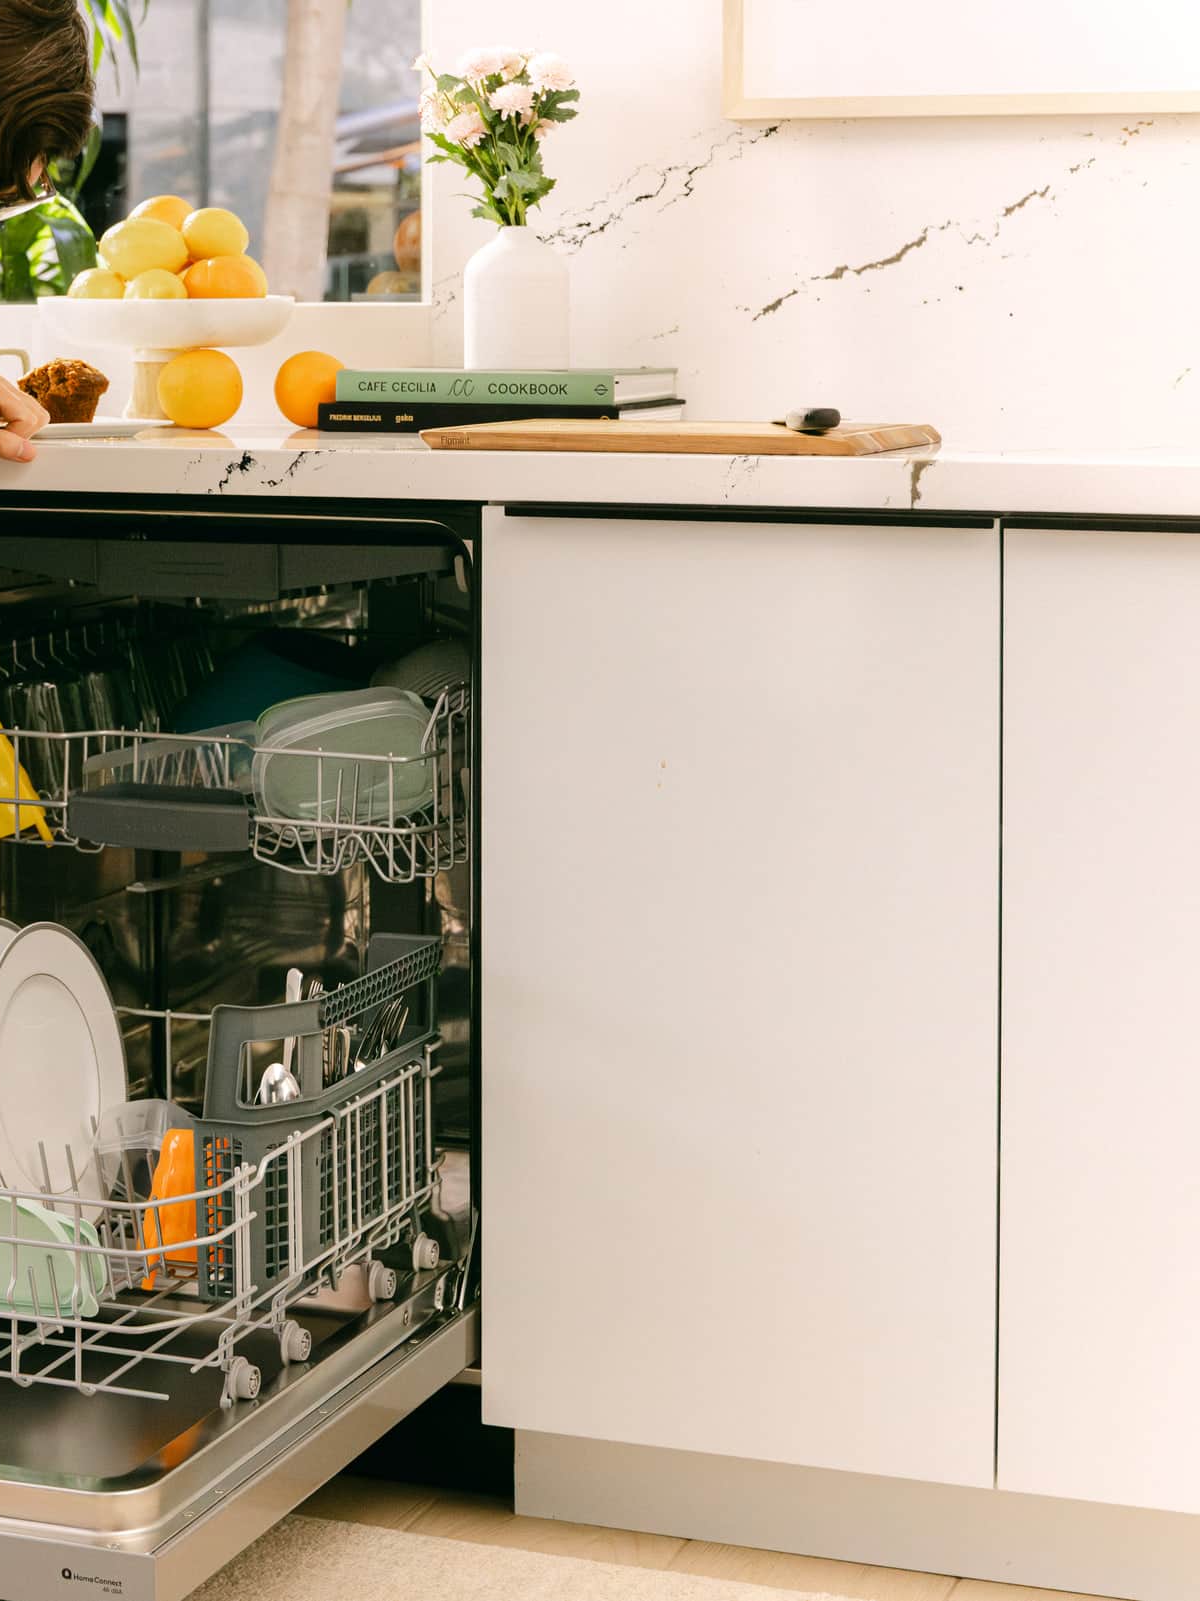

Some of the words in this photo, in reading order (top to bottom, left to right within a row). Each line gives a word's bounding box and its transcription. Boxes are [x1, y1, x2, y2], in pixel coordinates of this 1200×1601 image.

[358, 381, 387, 392] CAFE
[391, 381, 437, 393] CECILIA
[487, 382, 569, 396] COOKBOOK
